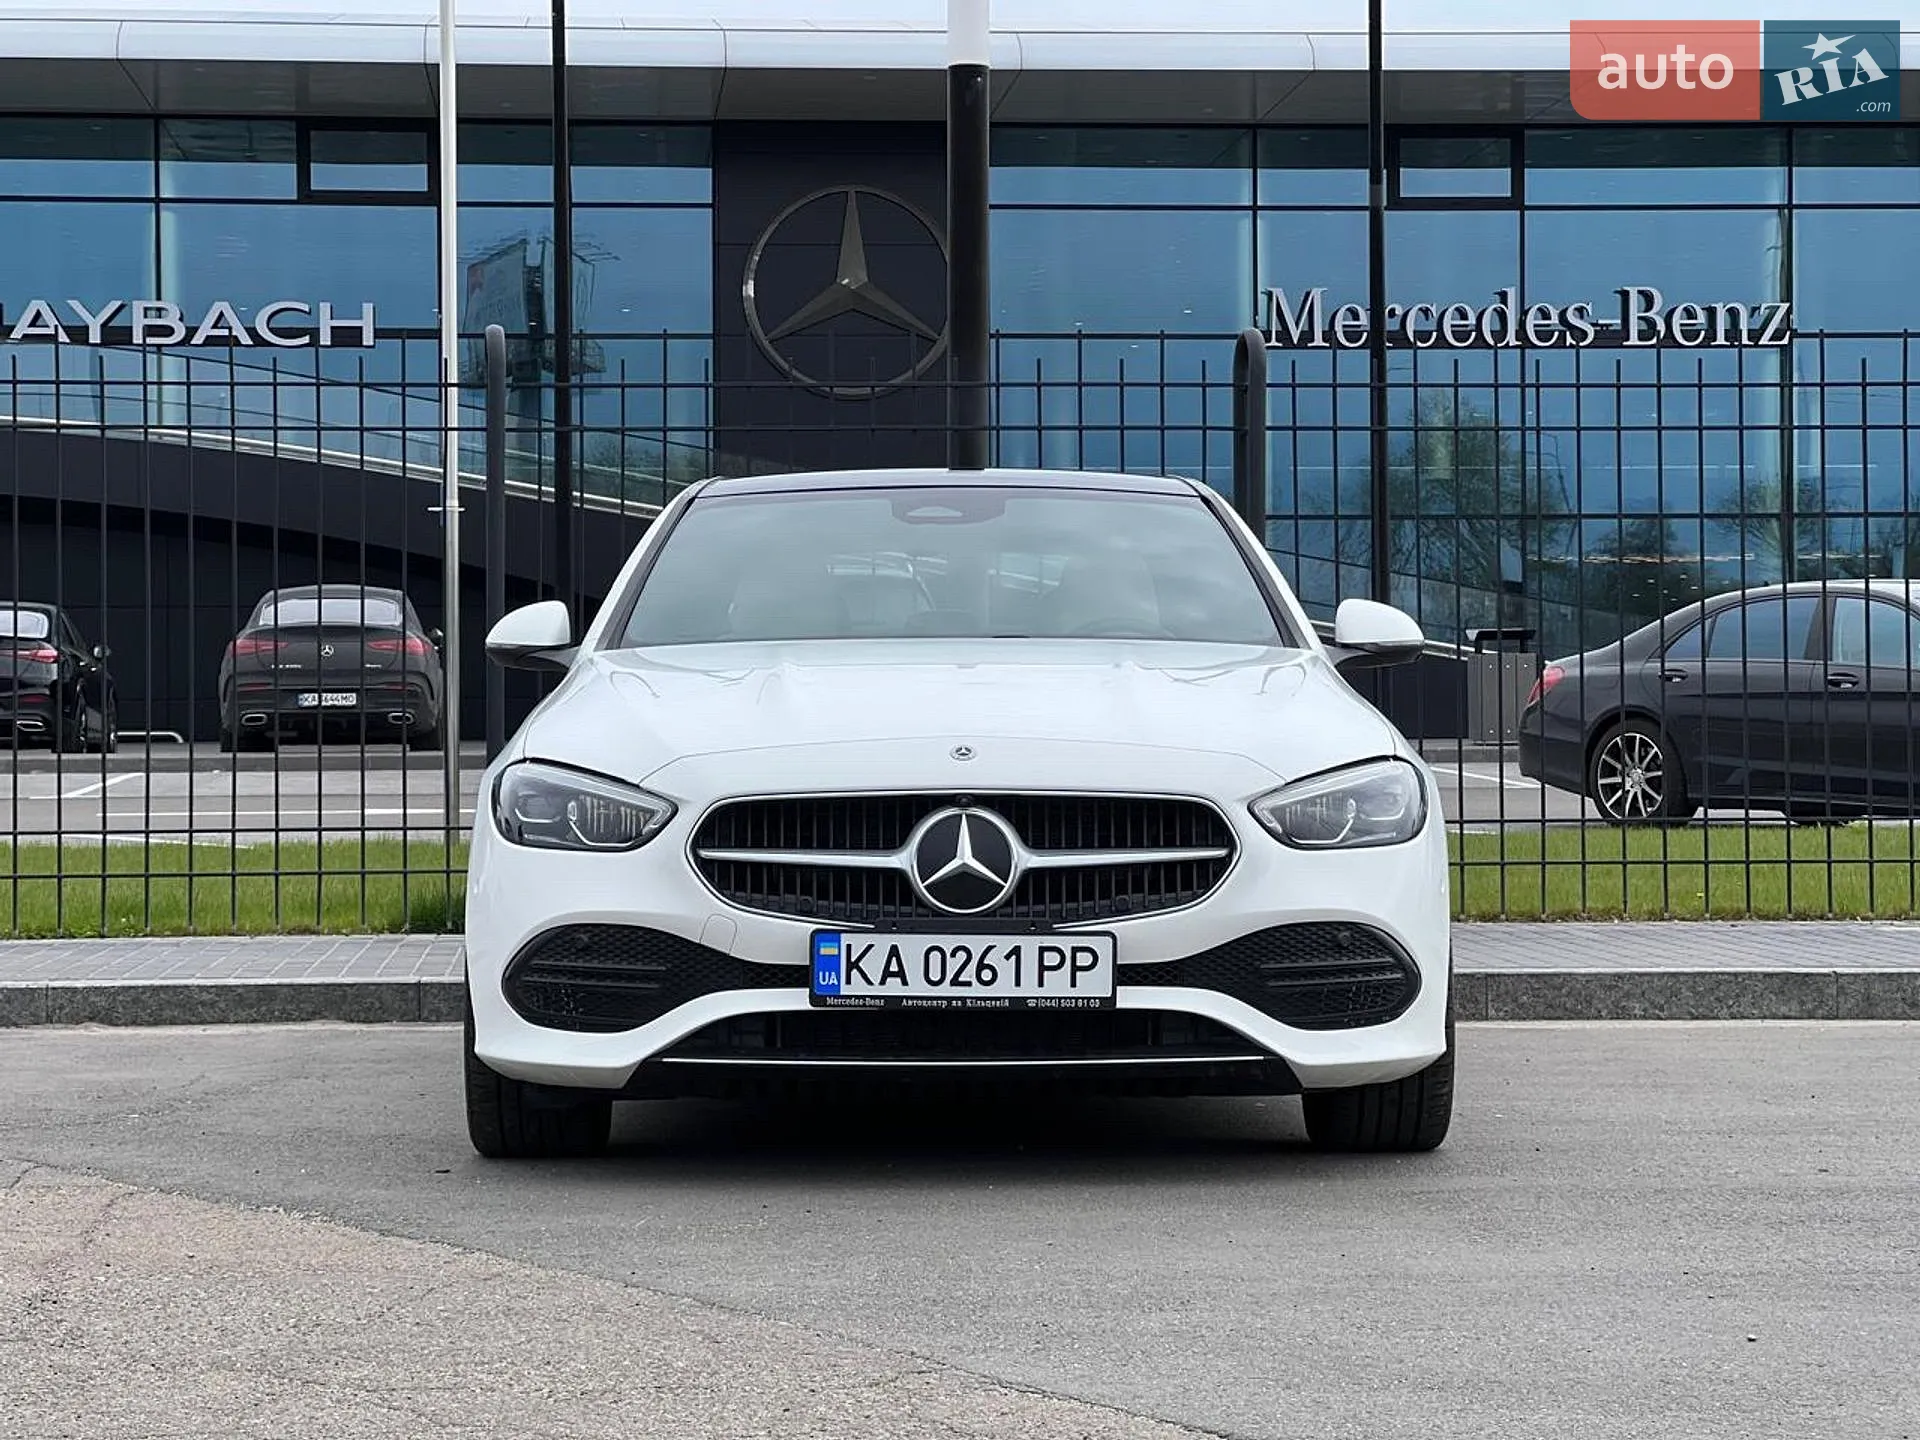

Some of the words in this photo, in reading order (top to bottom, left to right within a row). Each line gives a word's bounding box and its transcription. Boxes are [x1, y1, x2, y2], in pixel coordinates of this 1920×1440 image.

[1267, 286, 1792, 348] Mercedes-Benz
[819, 972, 838, 985] UA
[845, 943, 908, 987] KA
[924, 944, 1022, 988] 0261
[1038, 945, 1099, 988] PP
[826, 997, 885, 1006] Mercedes-Benz
